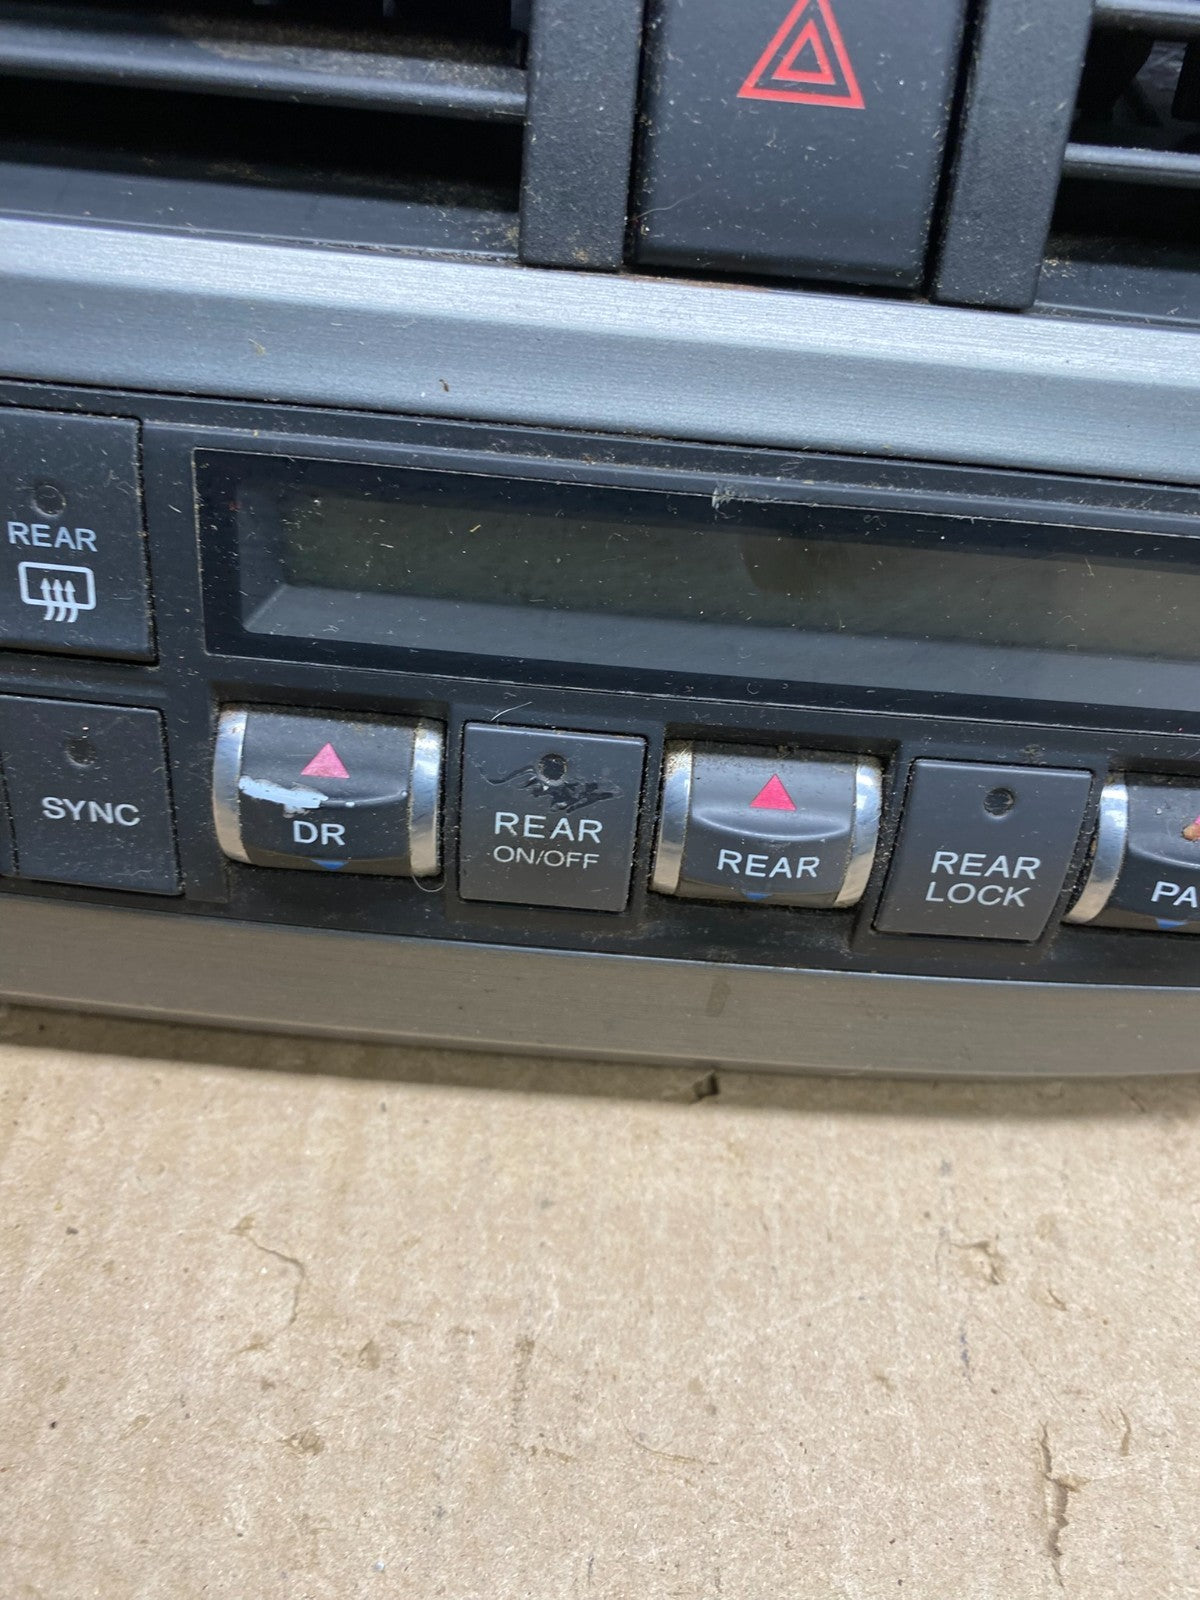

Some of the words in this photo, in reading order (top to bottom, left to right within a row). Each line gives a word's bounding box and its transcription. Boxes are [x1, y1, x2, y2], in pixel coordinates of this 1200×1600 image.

[7, 521, 98, 552] REAR
[41, 796, 141, 826] SYNC
[292, 820, 346, 846] DR
[494, 811, 603, 844] REAR
[493, 845, 600, 869] ON/OFF
[717, 848, 820, 879] REAR
[931, 851, 1041, 880] REAR
[925, 881, 1031, 908] LOCK
